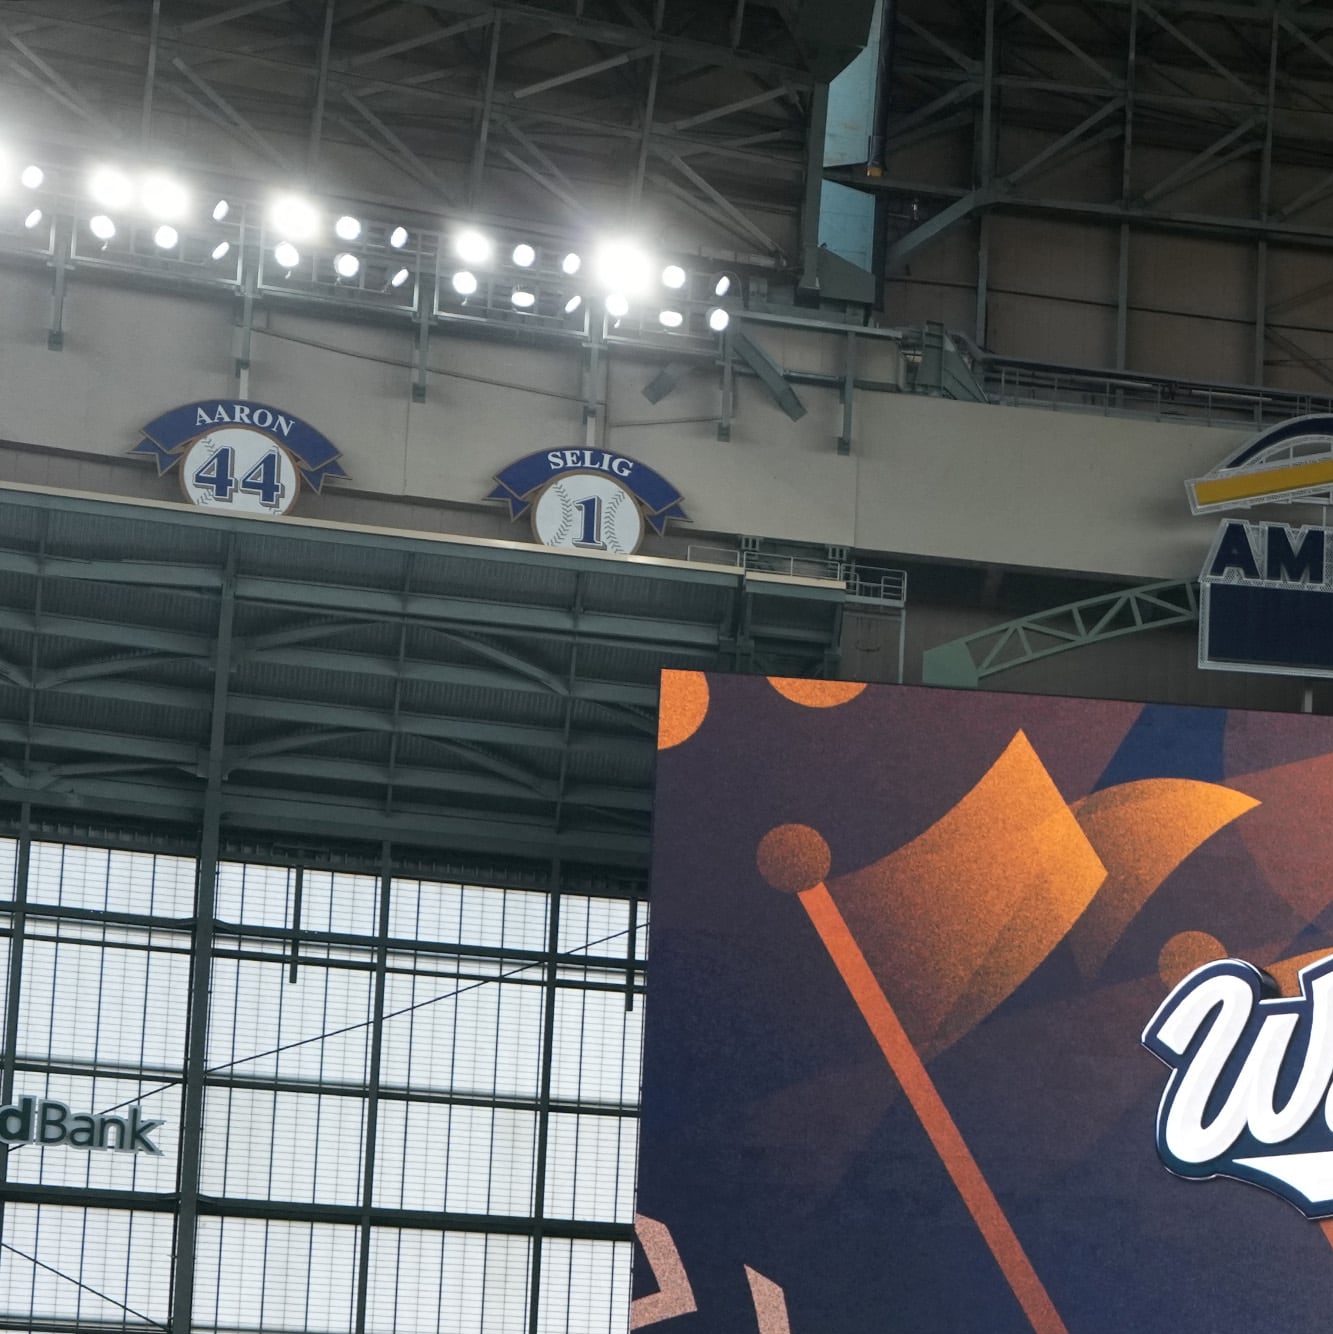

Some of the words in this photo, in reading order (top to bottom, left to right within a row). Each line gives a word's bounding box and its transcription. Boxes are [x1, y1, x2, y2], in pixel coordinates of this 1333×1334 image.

[195, 404, 295, 437] AARON
[192, 445, 287, 508] 44
[547, 450, 634, 477] SELIG
[572, 495, 607, 551] 1
